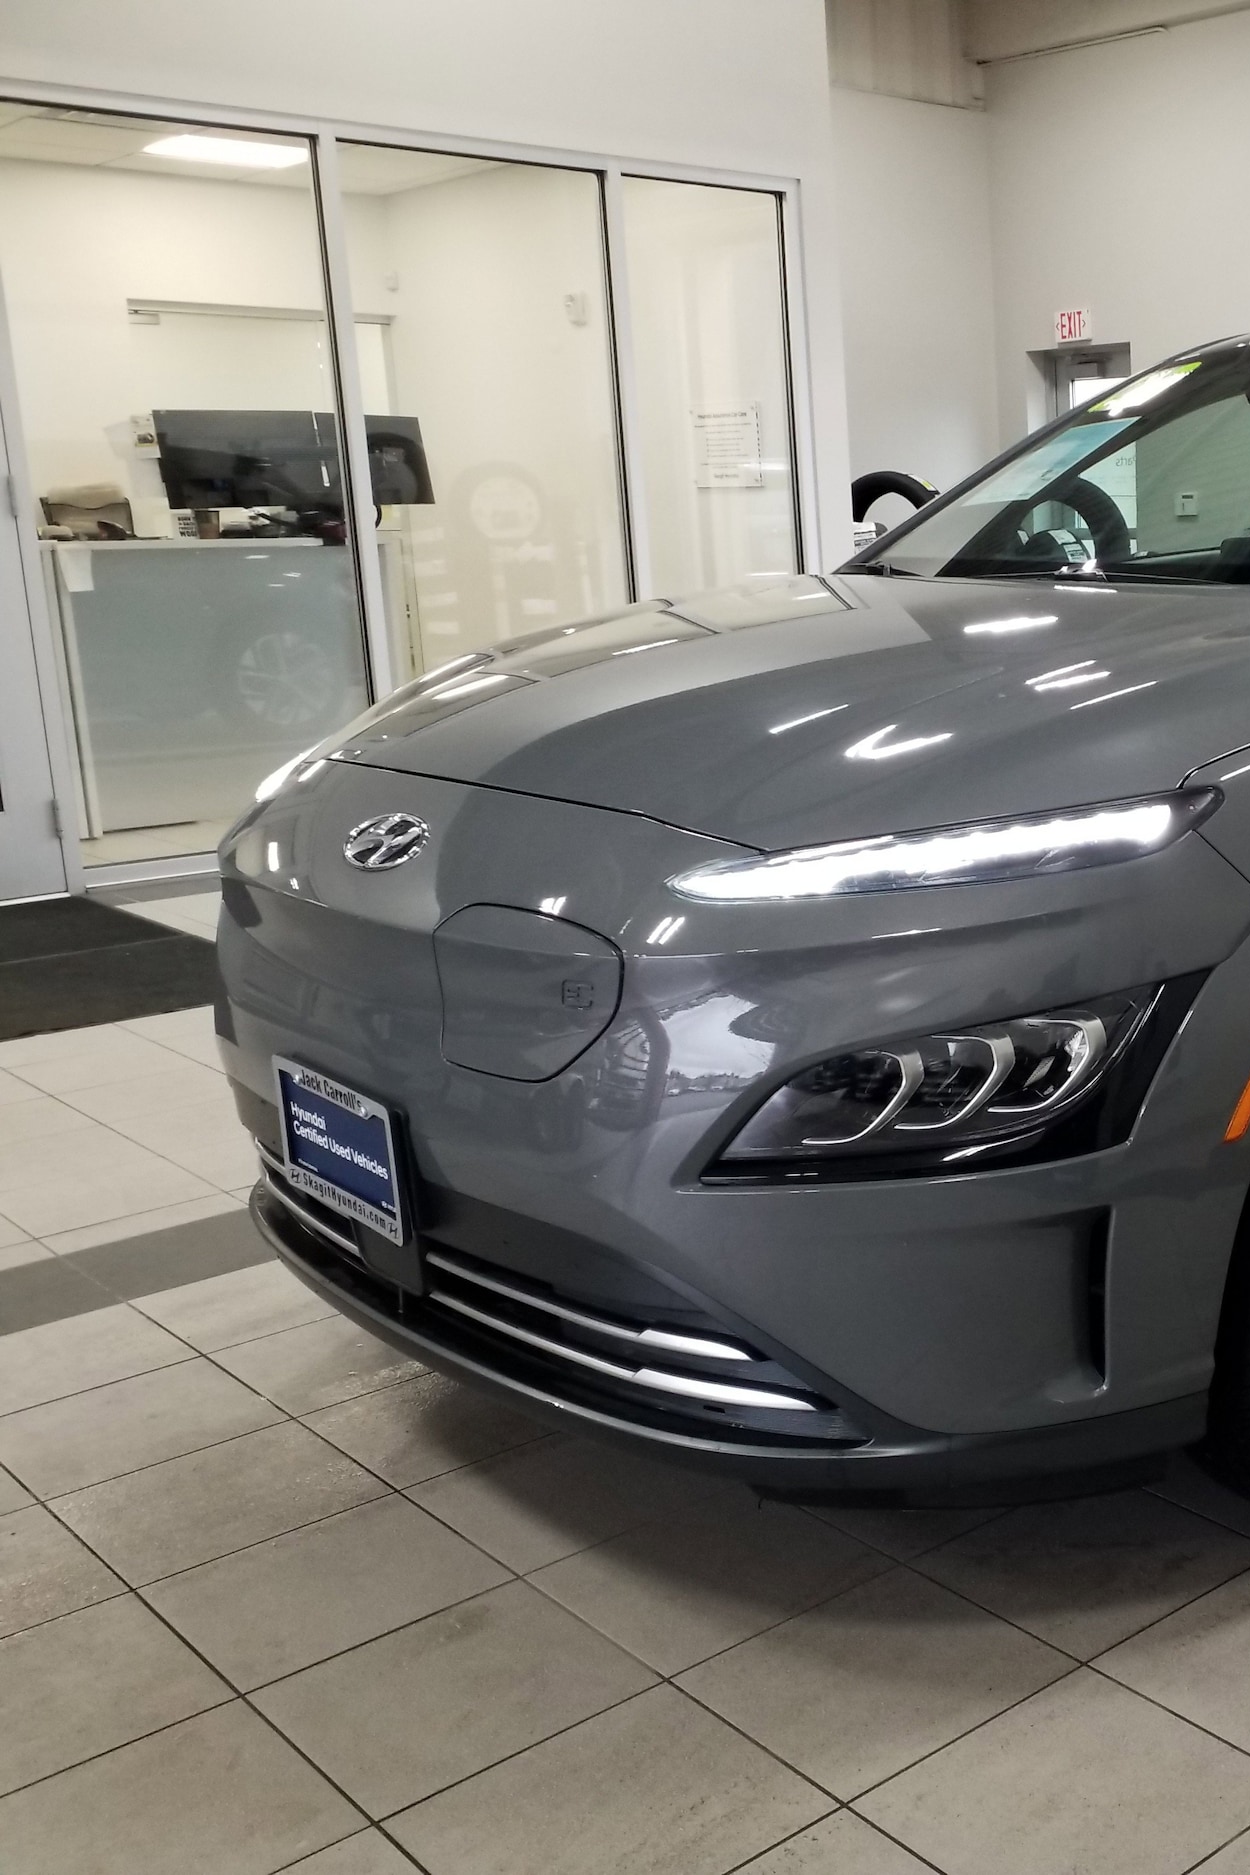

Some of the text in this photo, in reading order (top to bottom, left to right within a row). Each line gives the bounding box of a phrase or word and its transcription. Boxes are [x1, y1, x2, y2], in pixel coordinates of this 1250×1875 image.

[1060, 311, 1082, 339] EXIT
[300, 1069, 361, 1110] Jack Carroll's
[290, 1101, 326, 1131] Hyundai
[293, 1120, 328, 1150] Certified
[328, 1138, 352, 1161] Used
[350, 1148, 389, 1180] Vehicles
[302, 1172, 386, 1229] SkagitHyundai.com
